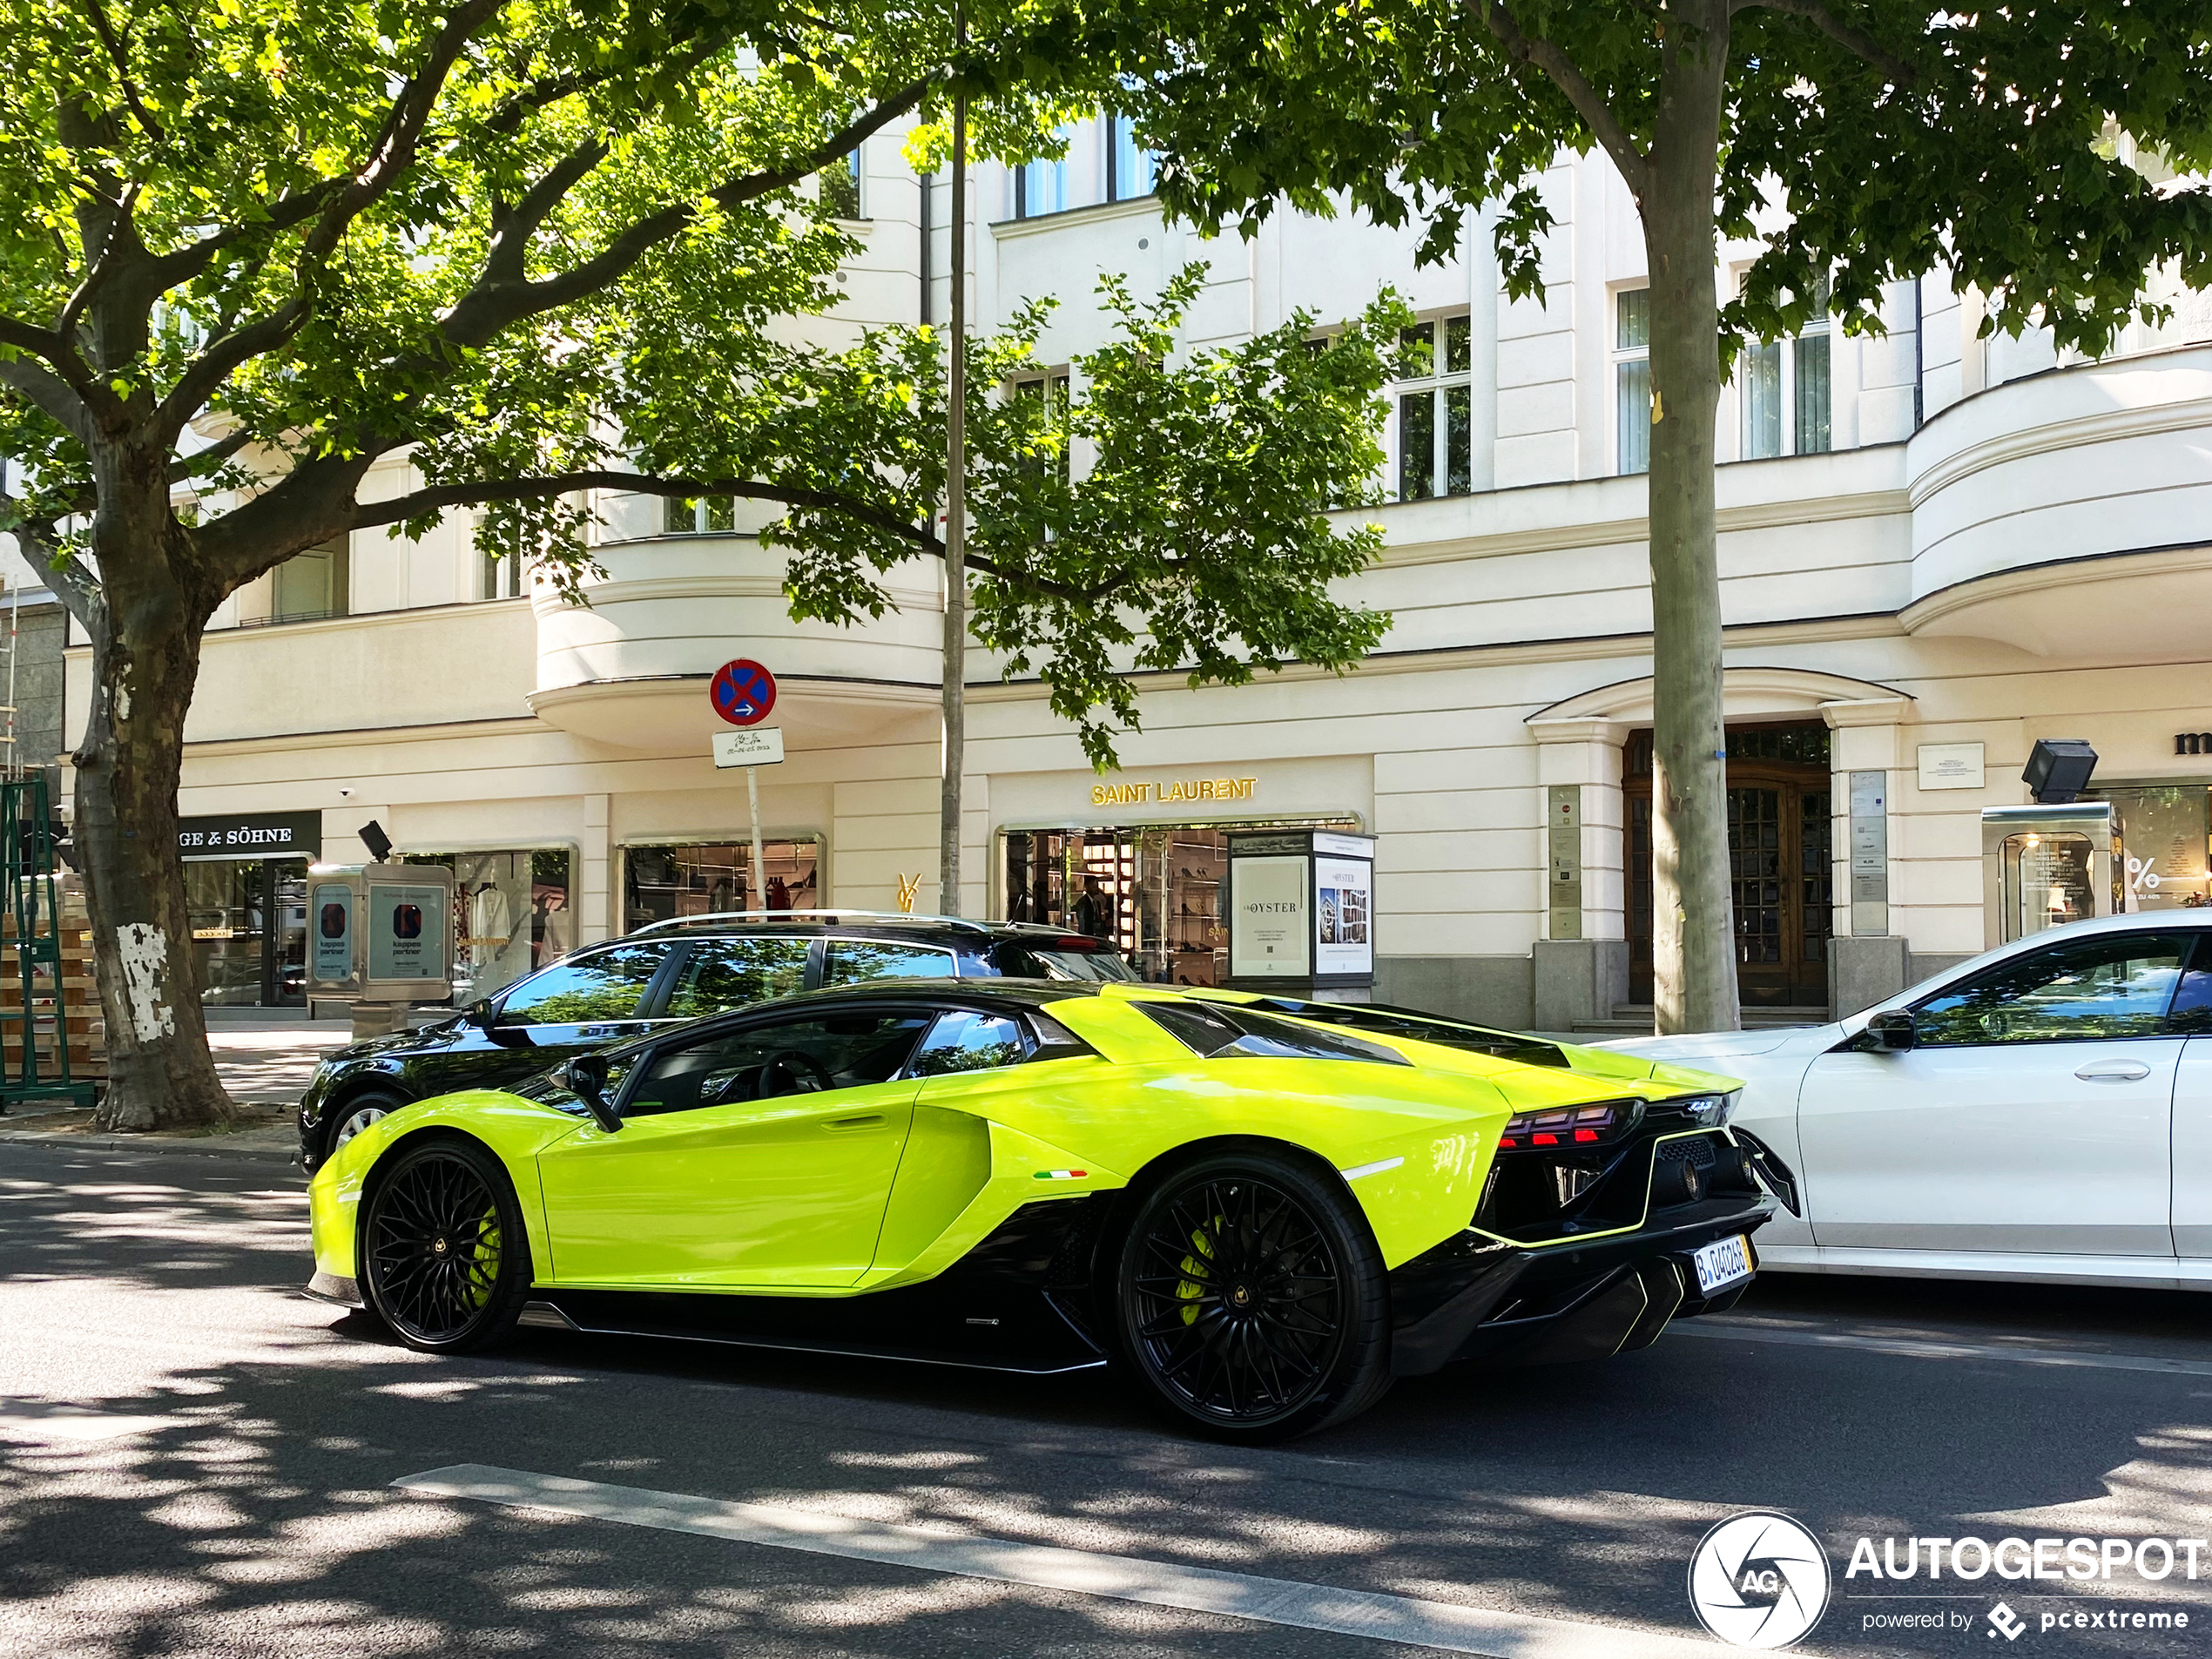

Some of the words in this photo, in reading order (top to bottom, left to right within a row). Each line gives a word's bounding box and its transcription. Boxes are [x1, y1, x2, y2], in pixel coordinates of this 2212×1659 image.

[1091, 783, 1152, 806] SAINT
[1157, 777, 1258, 802] LAURENT
[208, 832, 221, 846] &
[226, 826, 292, 845] SÖHNE
[1250, 902, 1296, 913] OYSTER
[1696, 1254, 1708, 1285] B
